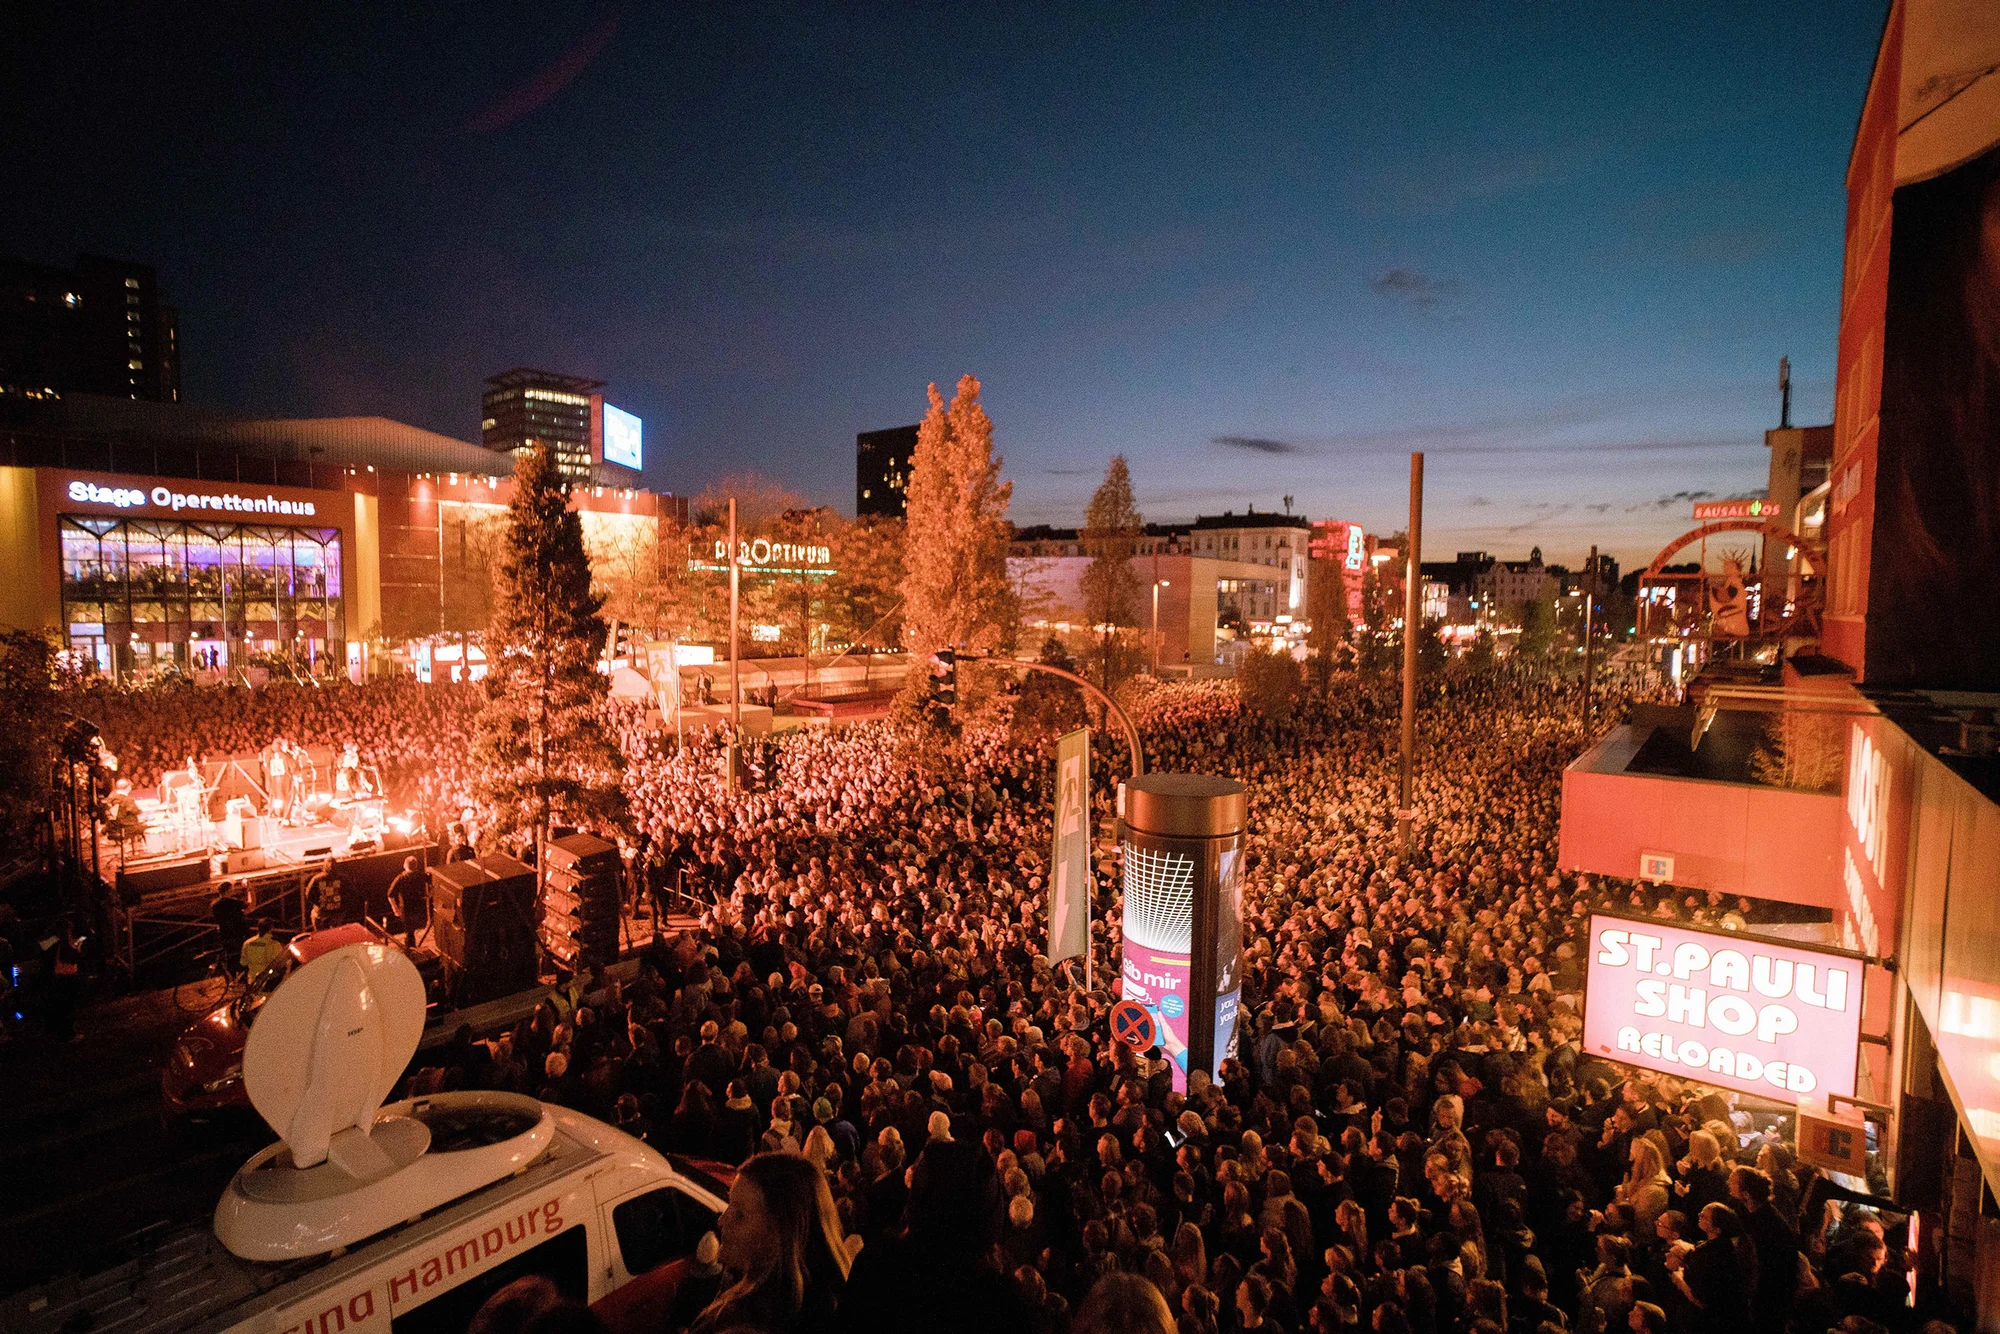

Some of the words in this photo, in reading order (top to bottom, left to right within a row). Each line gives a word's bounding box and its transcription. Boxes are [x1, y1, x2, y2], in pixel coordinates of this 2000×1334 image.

[68, 480, 147, 509] Stage
[151, 486, 316, 517] Operettenhaus
[1647, 859, 1666, 876] EC
[1122, 957, 1142, 981] Gib
[1144, 972, 1182, 990] mir
[1634, 979, 1799, 1045] SHOP
[1616, 1025, 1819, 1094] RELOADED
